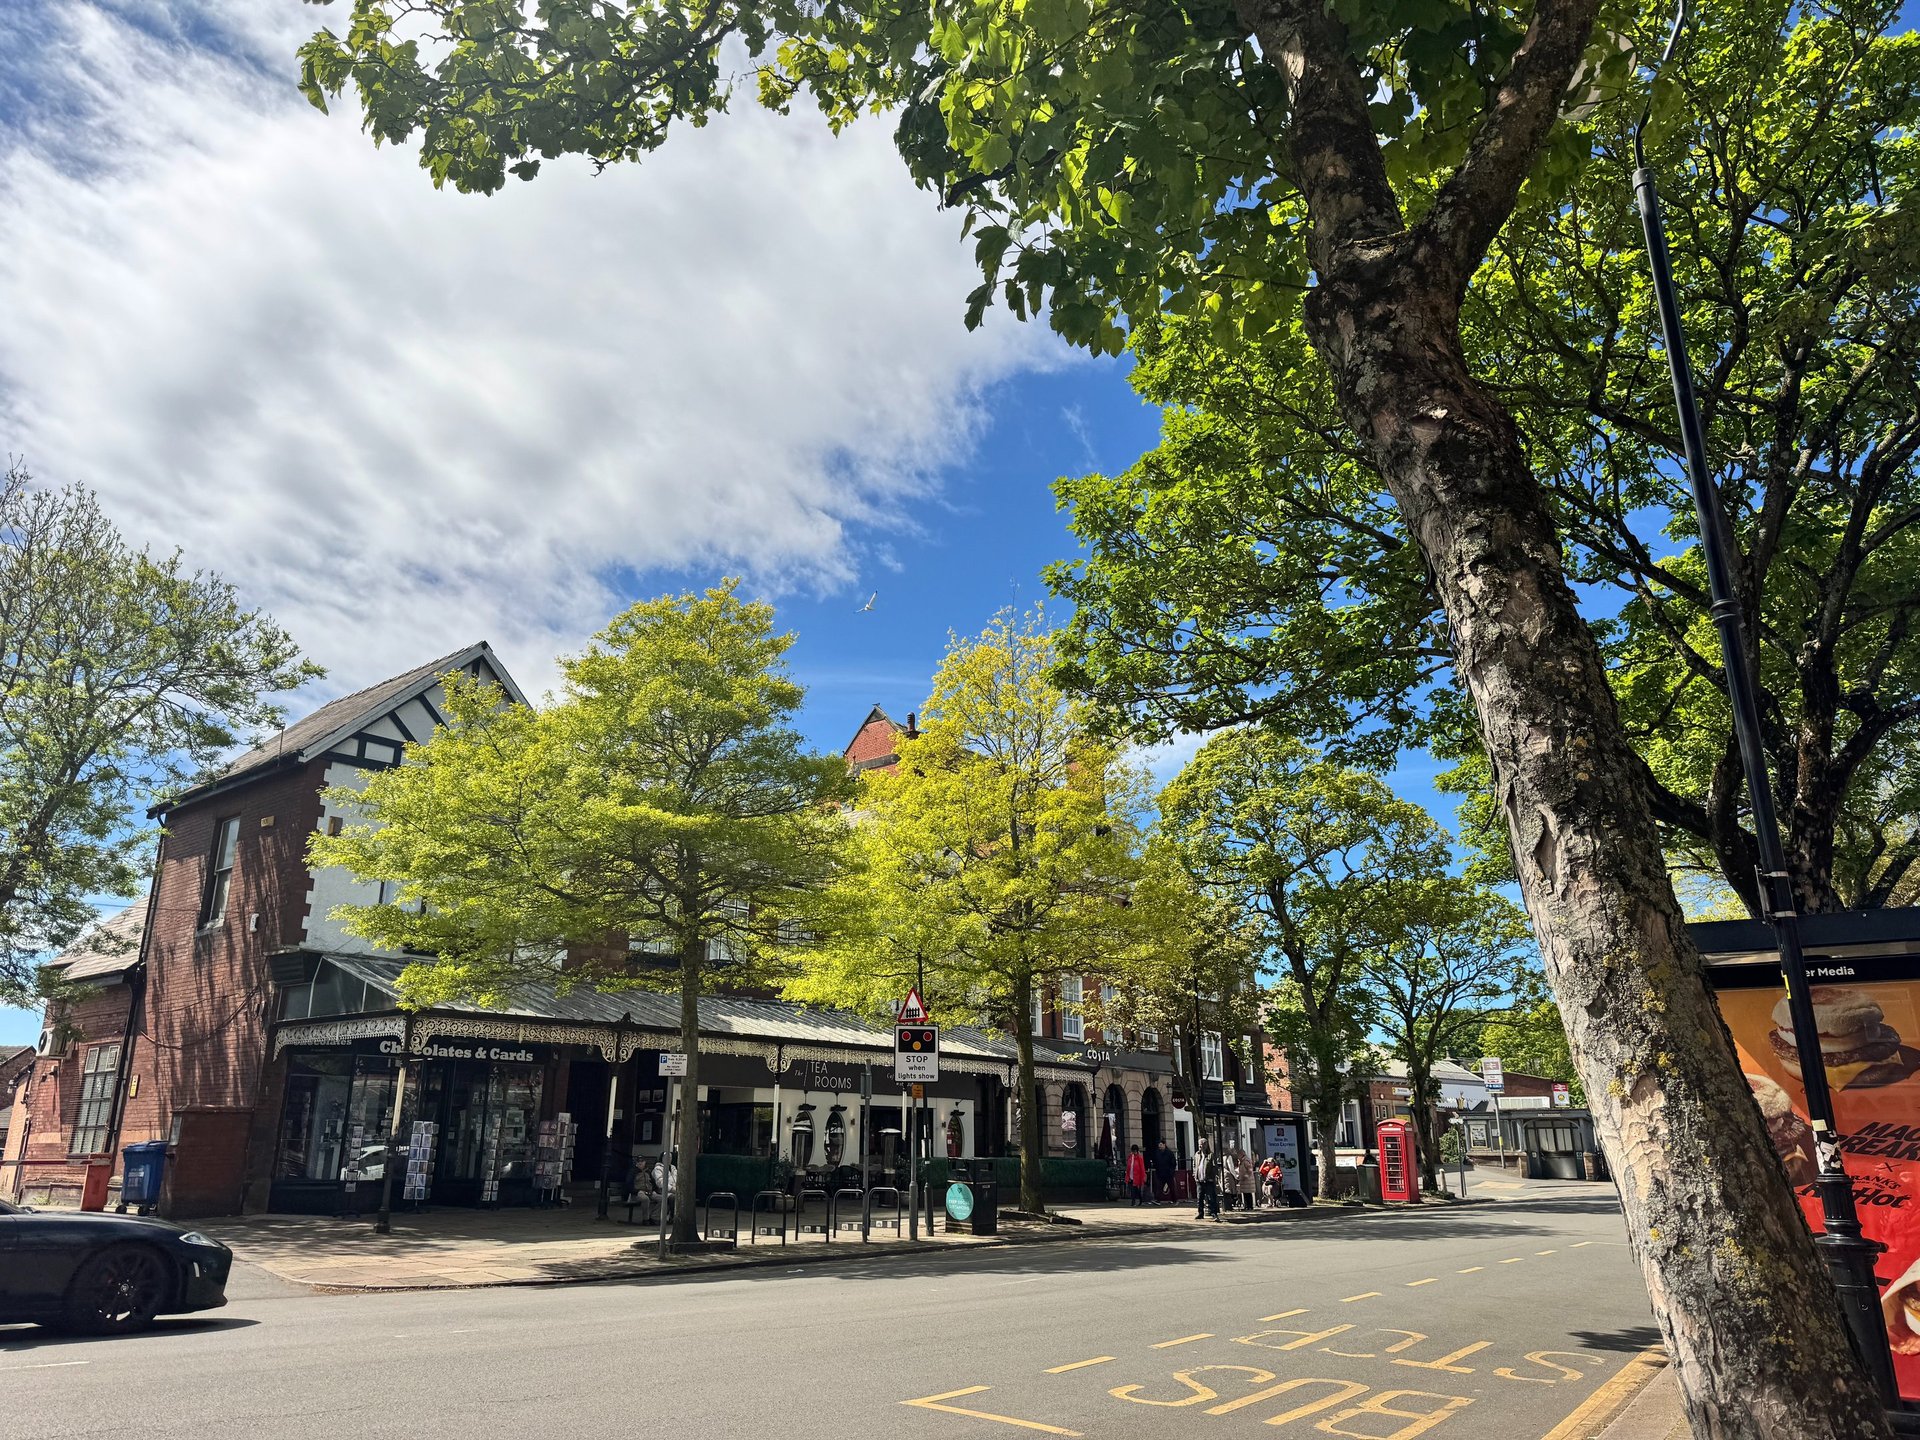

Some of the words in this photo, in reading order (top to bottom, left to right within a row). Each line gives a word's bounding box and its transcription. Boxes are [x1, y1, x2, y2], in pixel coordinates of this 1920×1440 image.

[1817, 966, 1855, 976] Media
[379, 1041, 472, 1058] Chcolates
[474, 1047, 487, 1059] &
[489, 1048, 534, 1062] Cards
[1087, 1050, 1111, 1061] COSTA
[905, 1055, 929, 1063] STOP
[810, 1061, 828, 1074] TEA
[814, 1075, 852, 1089] ROOMS
[897, 1072, 917, 1080] lights
[1108, 1364, 1476, 1440] BUS
